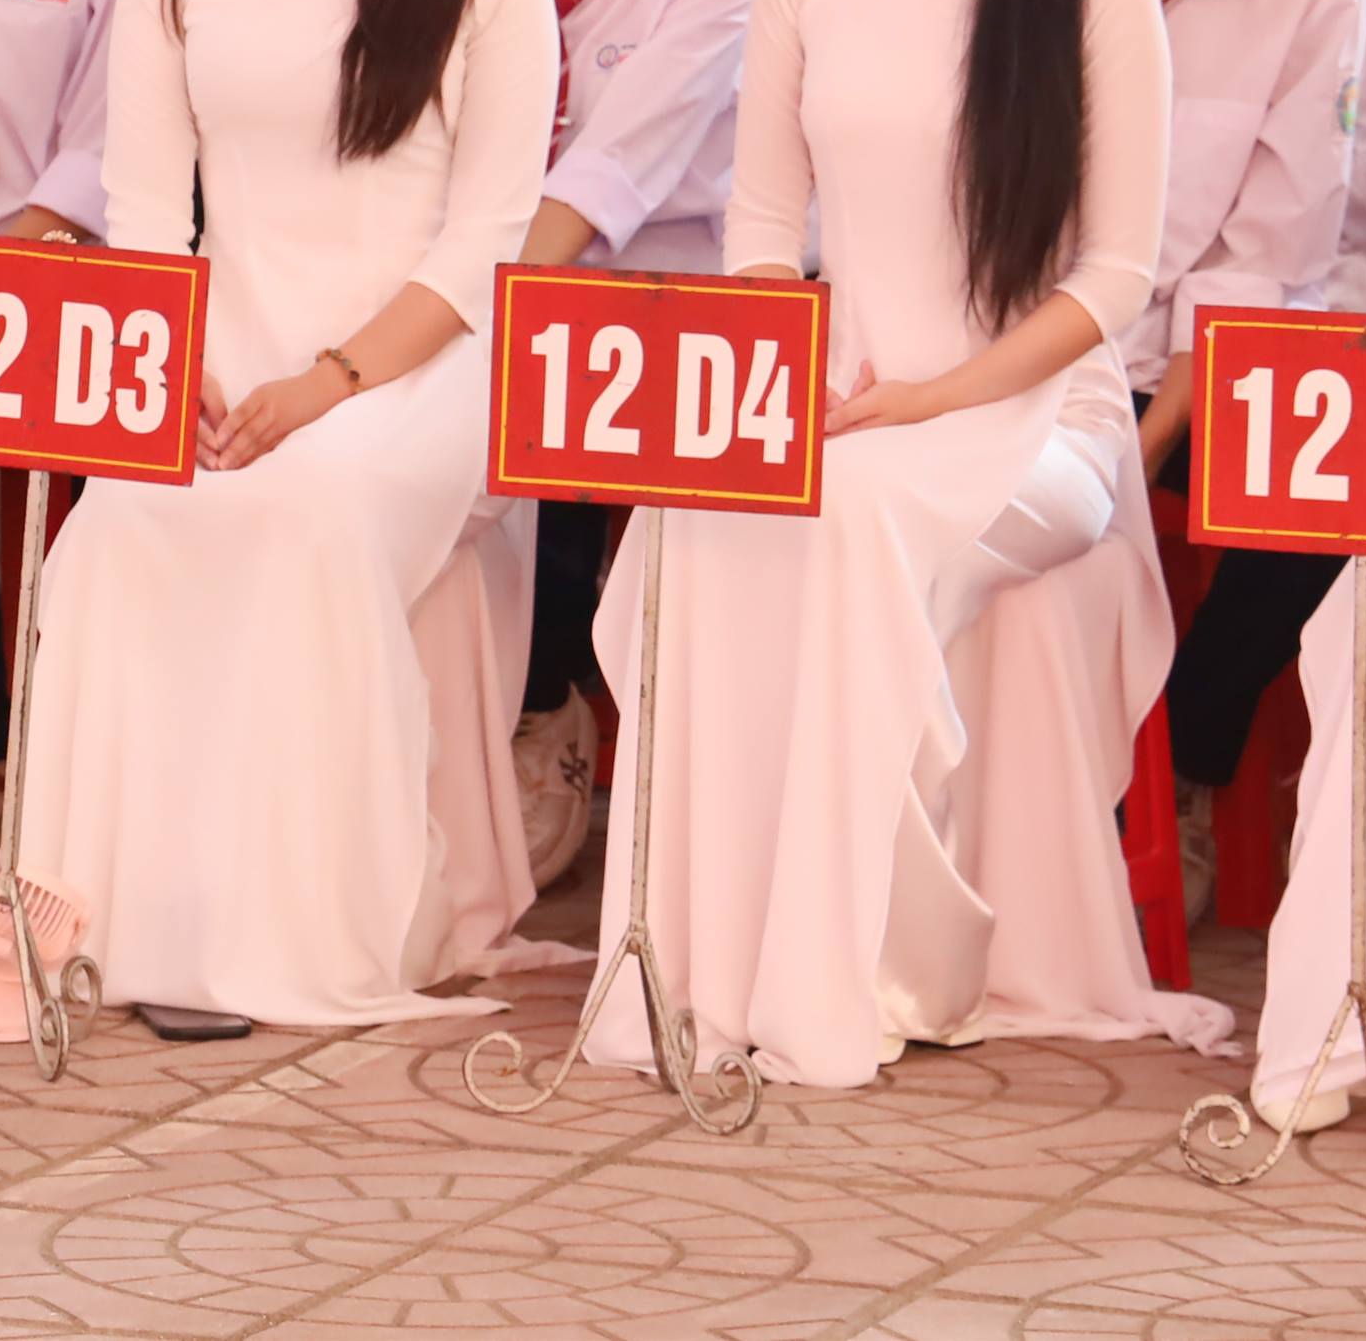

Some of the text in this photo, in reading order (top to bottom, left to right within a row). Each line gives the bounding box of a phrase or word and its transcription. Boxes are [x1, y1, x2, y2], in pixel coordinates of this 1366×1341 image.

[54, 302, 170, 434] D3
[531, 324, 795, 464] 12 D4
[1233, 368, 1352, 502] 12
